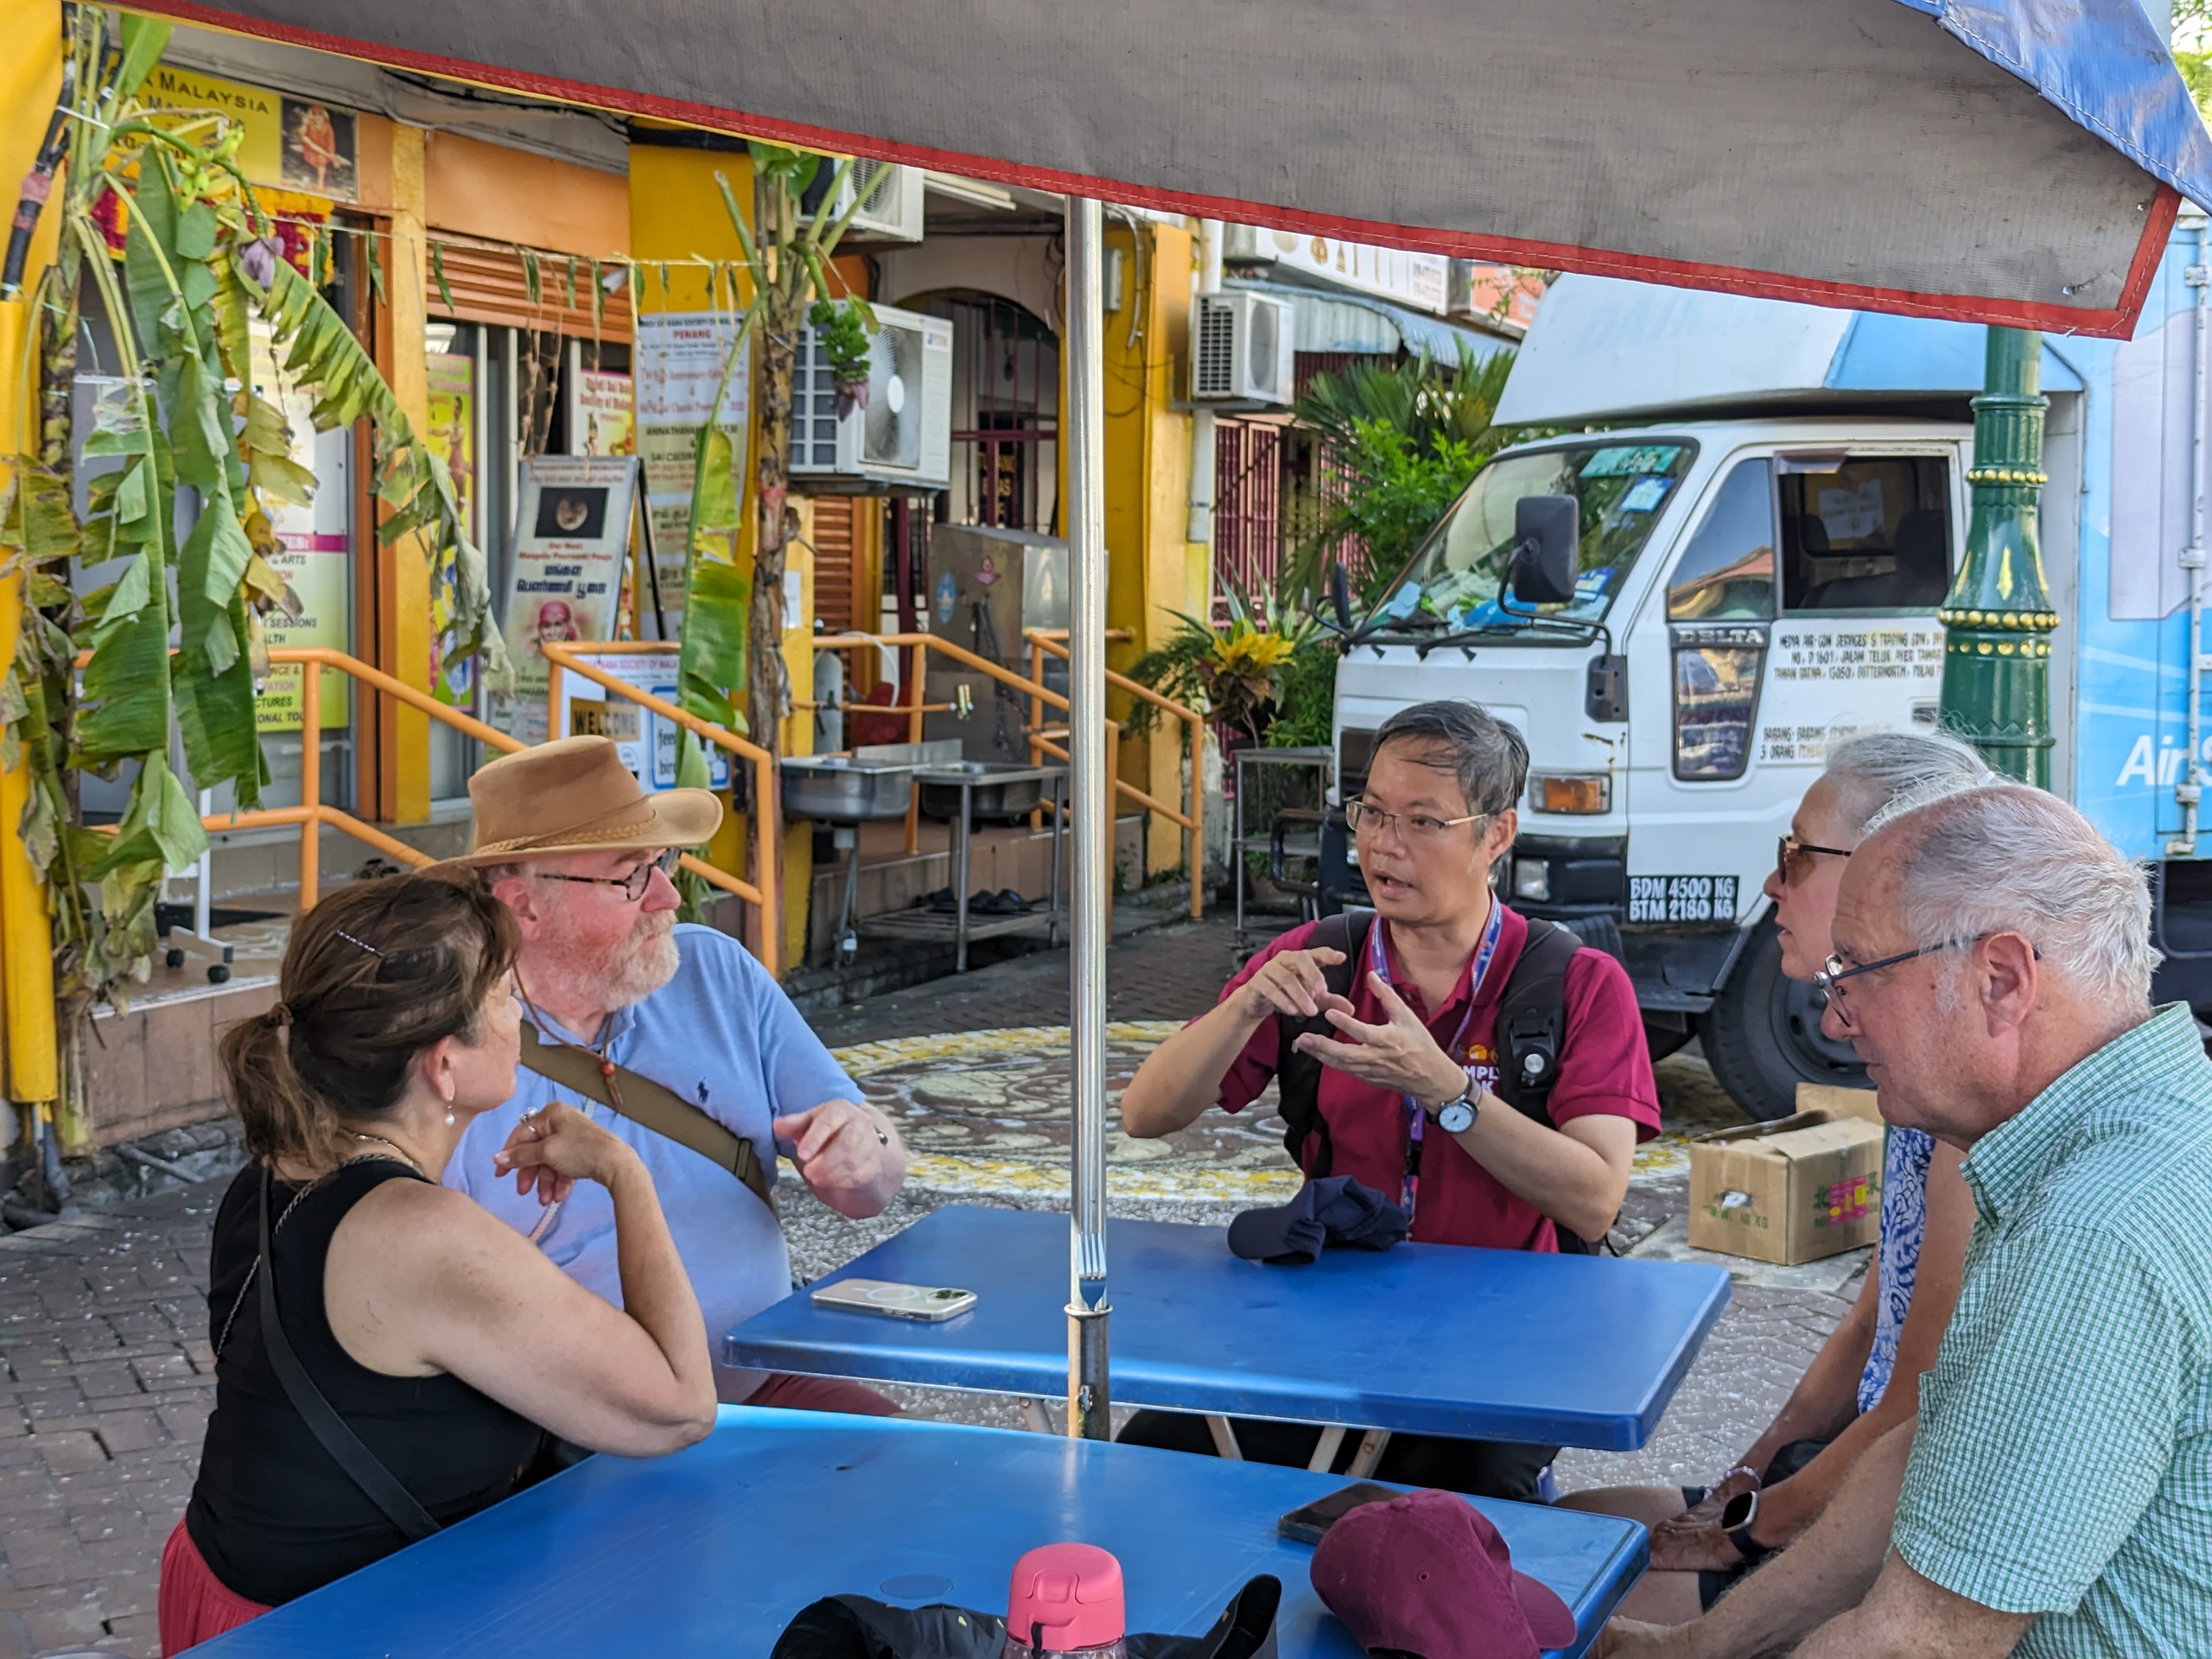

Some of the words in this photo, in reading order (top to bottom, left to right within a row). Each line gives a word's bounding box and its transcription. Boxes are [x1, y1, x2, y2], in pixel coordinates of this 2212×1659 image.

[159, 71, 270, 115] MALAYSIA
[672, 329, 712, 339] PENANG
[281, 555, 307, 566] ARTS
[1678, 629, 1764, 644] DELTA
[255, 696, 293, 708] CTURES
[574, 710, 636, 734] WELCOME
[1630, 877, 1668, 899] BDM
[1668, 877, 1712, 899] 4500
[1714, 877, 1736, 899] KG
[1629, 899, 1667, 922] BTM
[1669, 899, 1711, 921] 2180
[1713, 899, 1734, 921] KG
[1461, 1065, 1500, 1080] MPL
